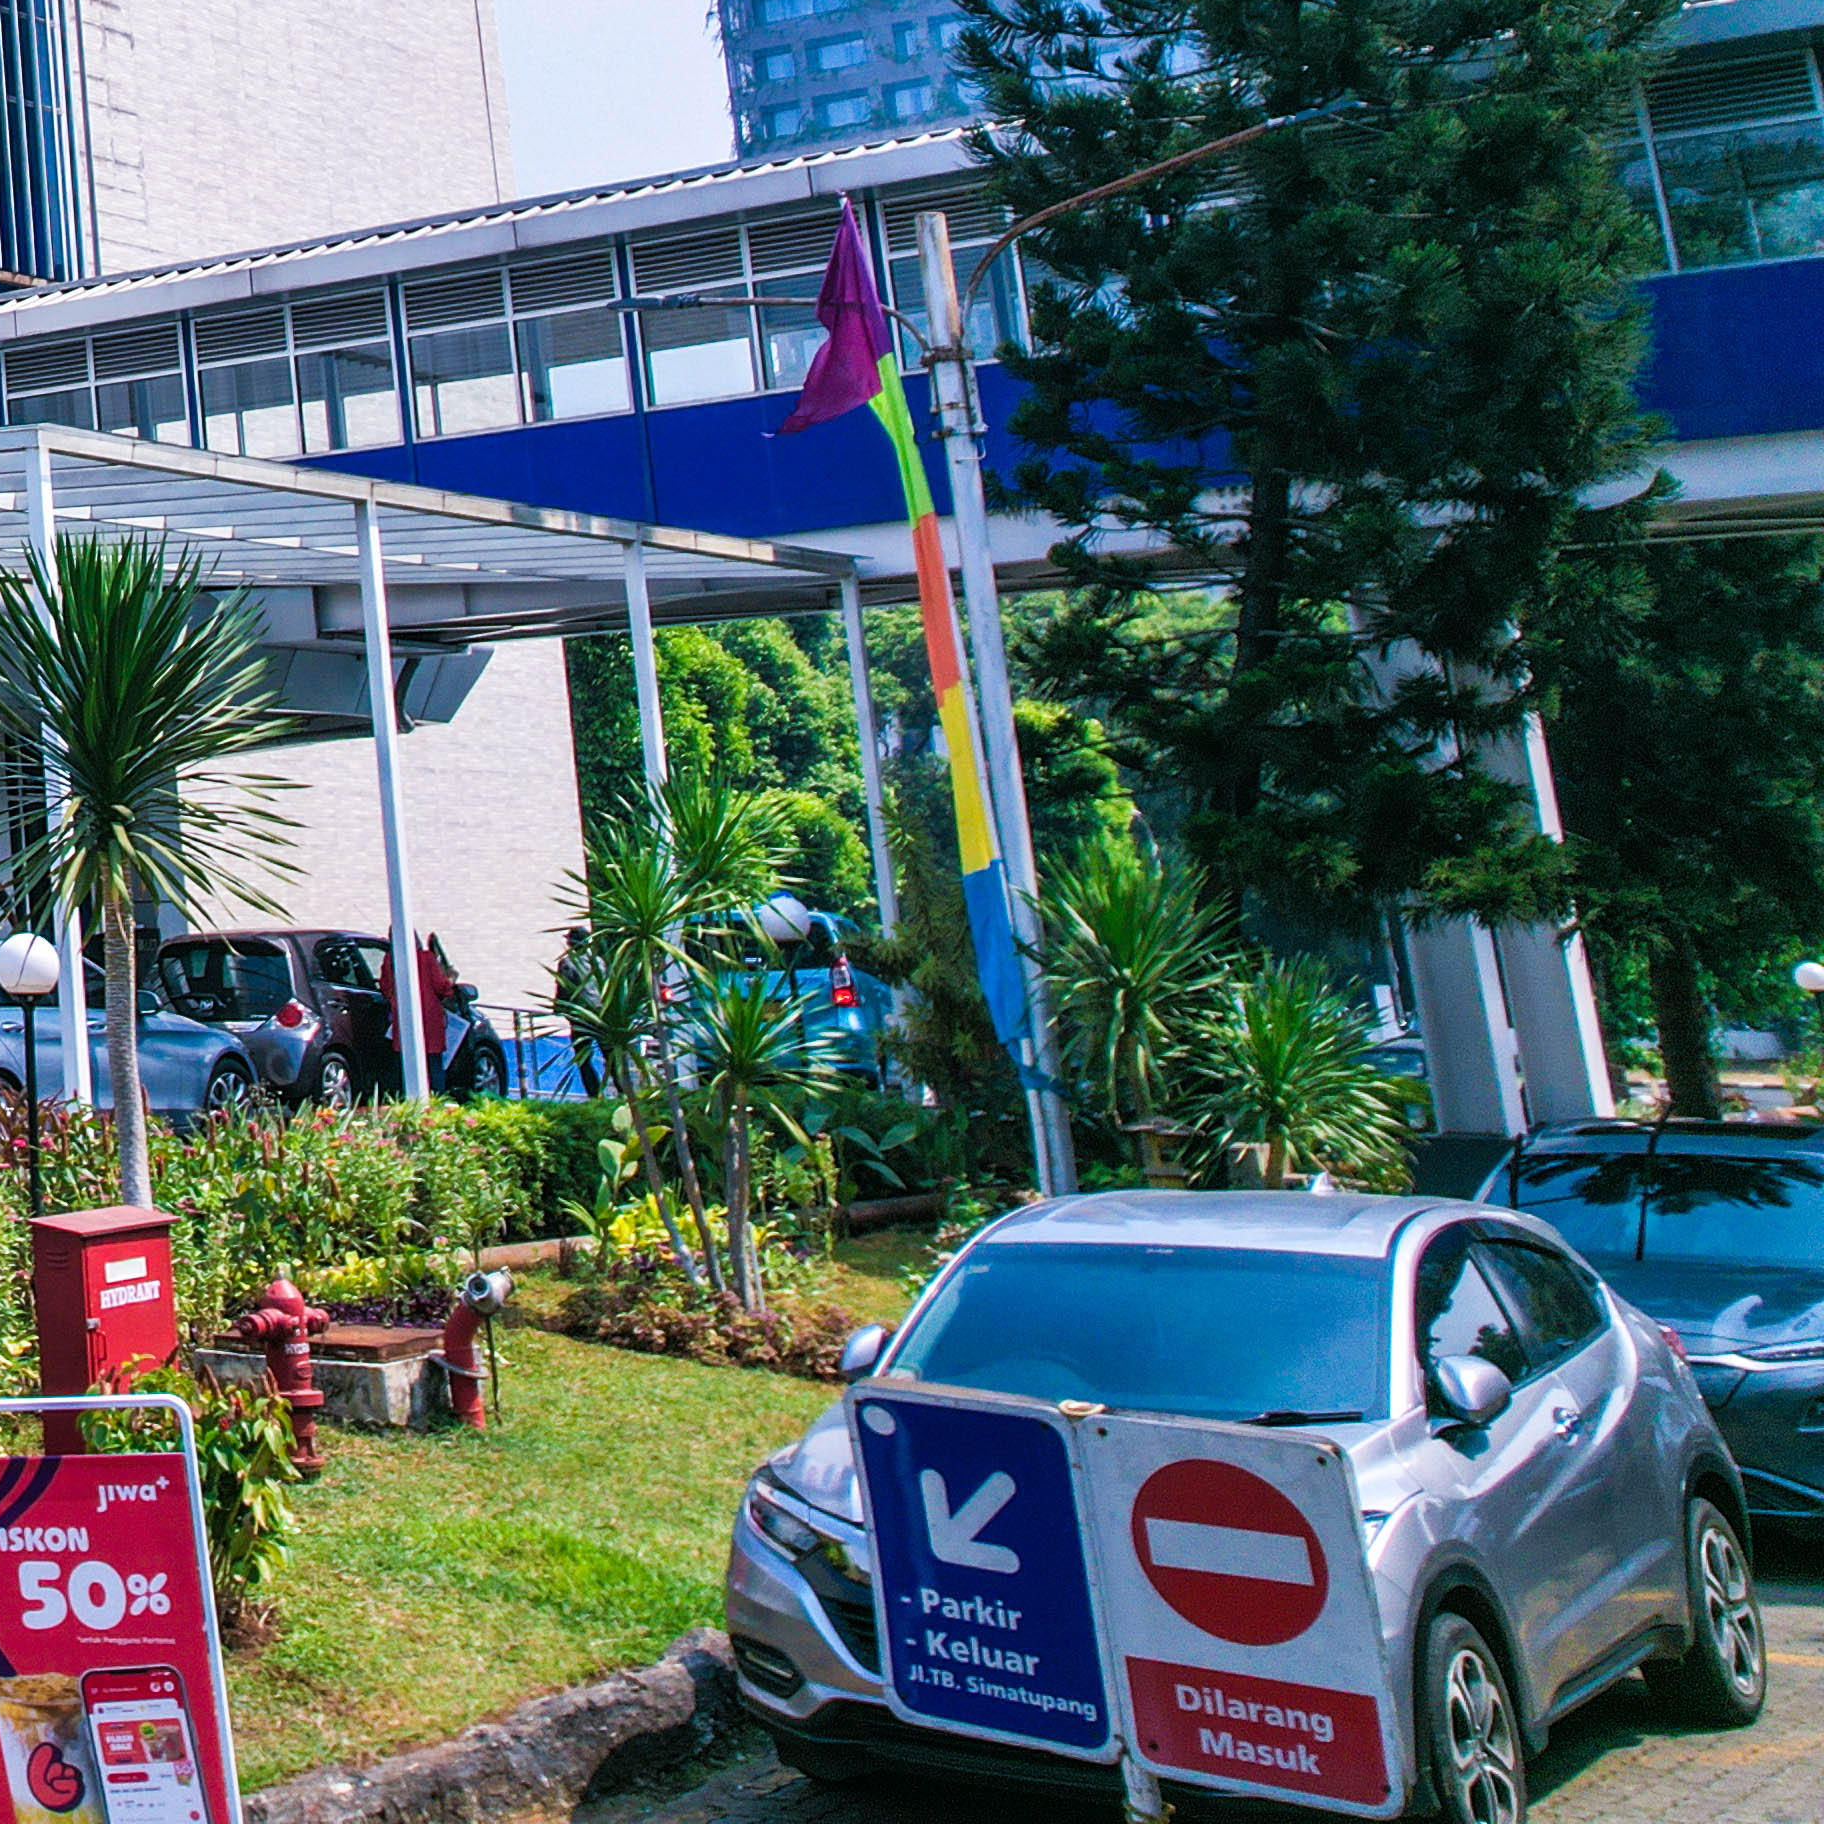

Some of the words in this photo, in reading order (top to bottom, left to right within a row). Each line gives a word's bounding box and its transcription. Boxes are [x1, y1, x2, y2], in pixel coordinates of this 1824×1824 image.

[100, 1280, 161, 1309] HYDRANT
[18, 1560, 171, 1631] 50%
[920, 1587, 1022, 1630] Parkir
[925, 1629, 1040, 1676] Keluar
[966, 1676, 1098, 1722] Simatupang
[1175, 1683, 1335, 1743] Dilarang
[1200, 1727, 1322, 1775] Masuk
